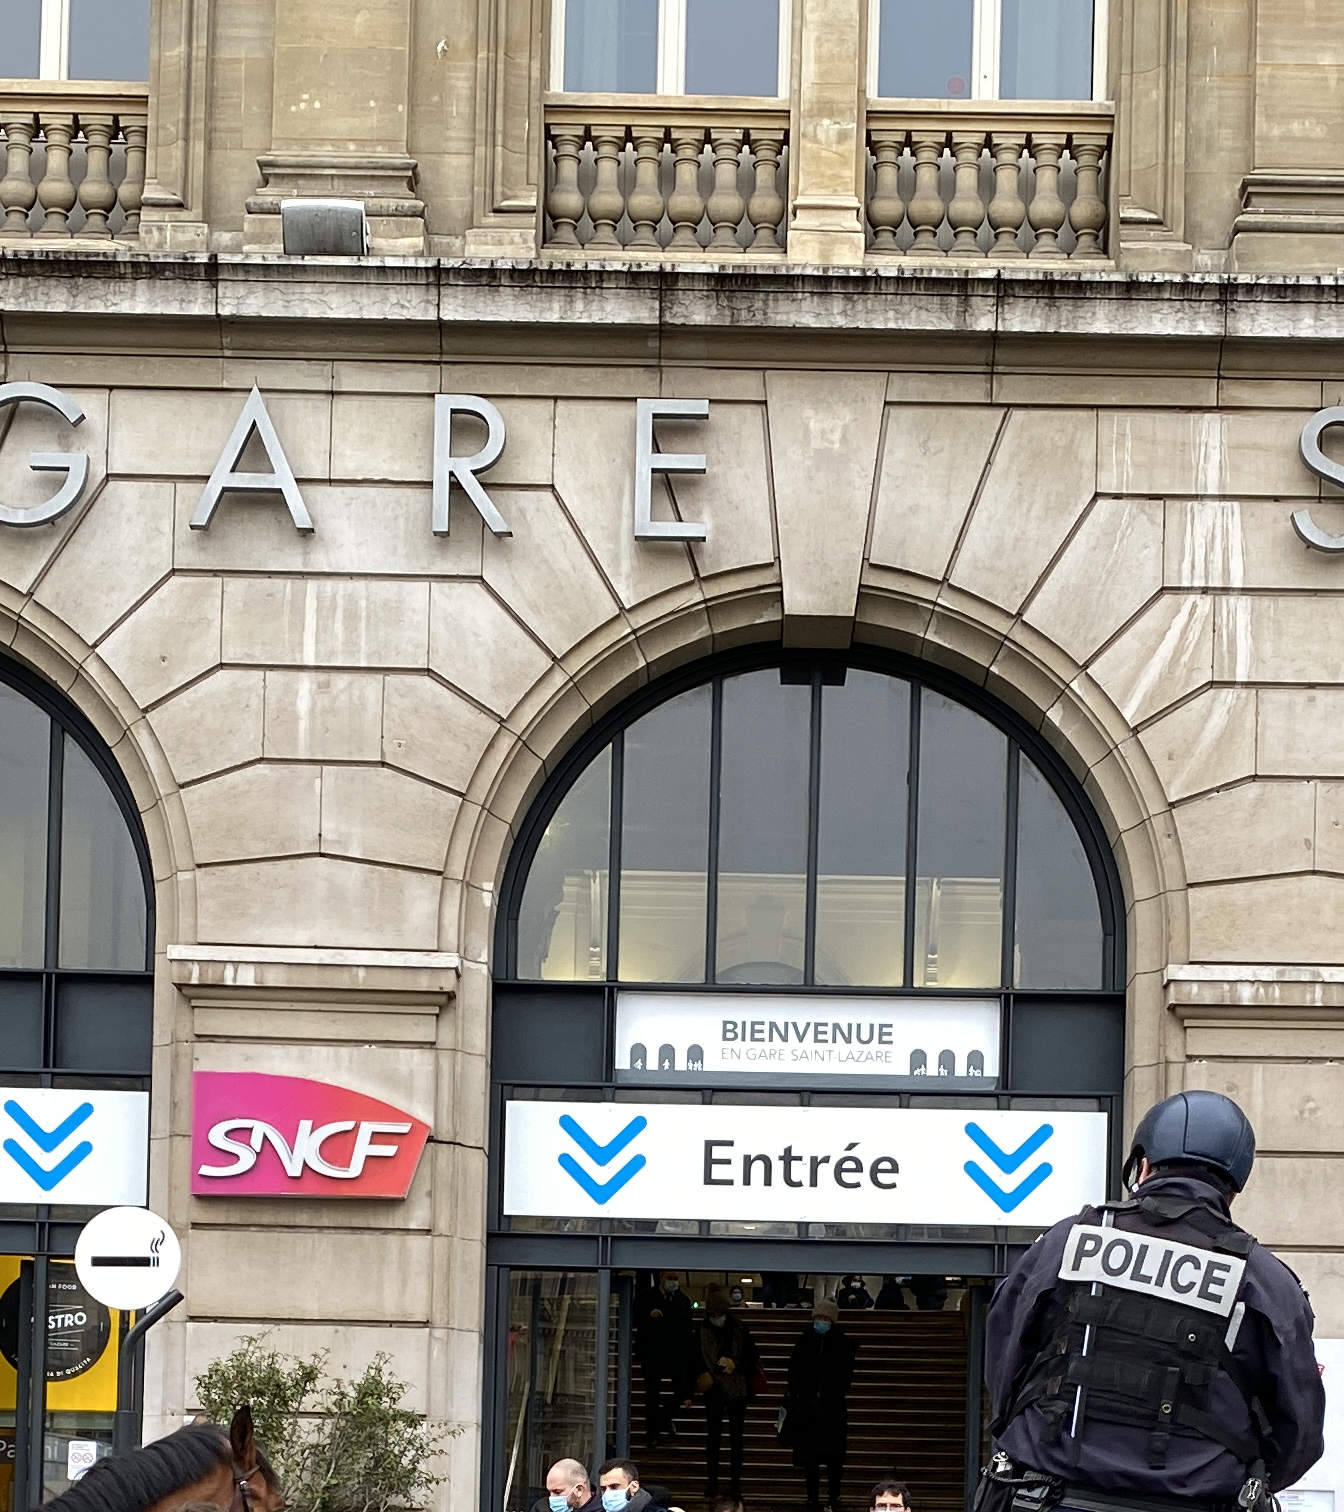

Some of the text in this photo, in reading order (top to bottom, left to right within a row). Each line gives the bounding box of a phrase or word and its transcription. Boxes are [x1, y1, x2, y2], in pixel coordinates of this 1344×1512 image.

[721, 1020, 894, 1045] BIENVENUE
[721, 1048, 893, 1063] EN GARE SAINT-LAZARE
[197, 1118, 413, 1180] SNCF
[703, 1139, 900, 1190] Entrée
[1071, 1232, 1231, 1304] POLICE
